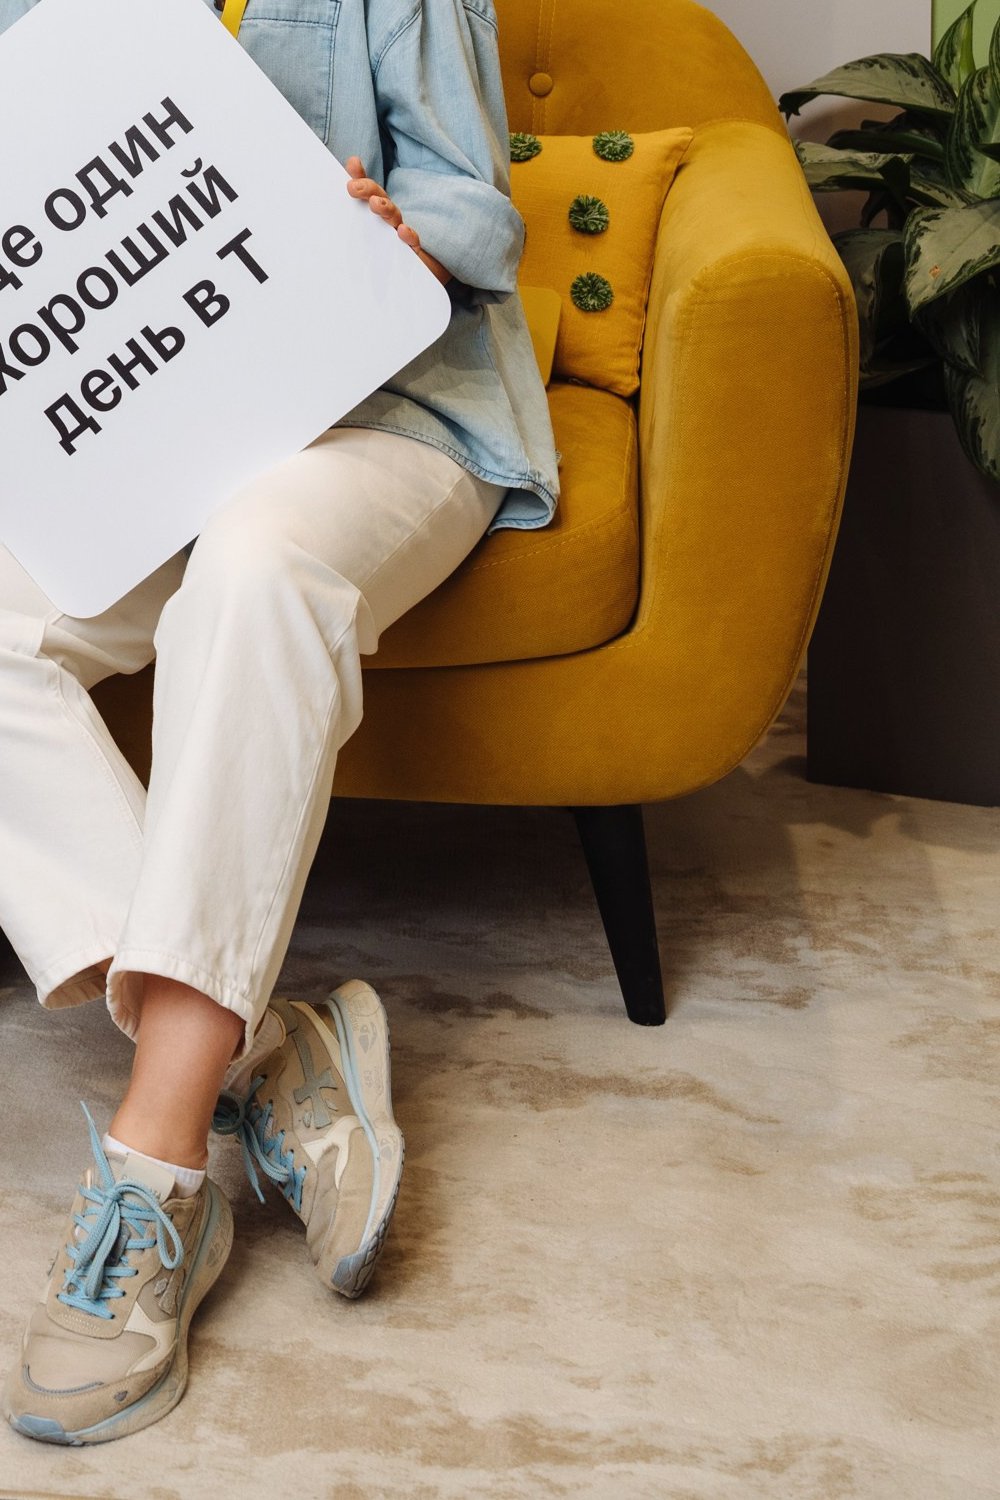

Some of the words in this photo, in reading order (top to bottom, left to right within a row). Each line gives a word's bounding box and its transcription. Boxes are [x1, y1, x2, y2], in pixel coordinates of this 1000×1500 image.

[44, 95, 195, 220] один
[43, 324, 186, 457] день
[181, 278, 231, 329] в
[215, 226, 270, 285] Т
